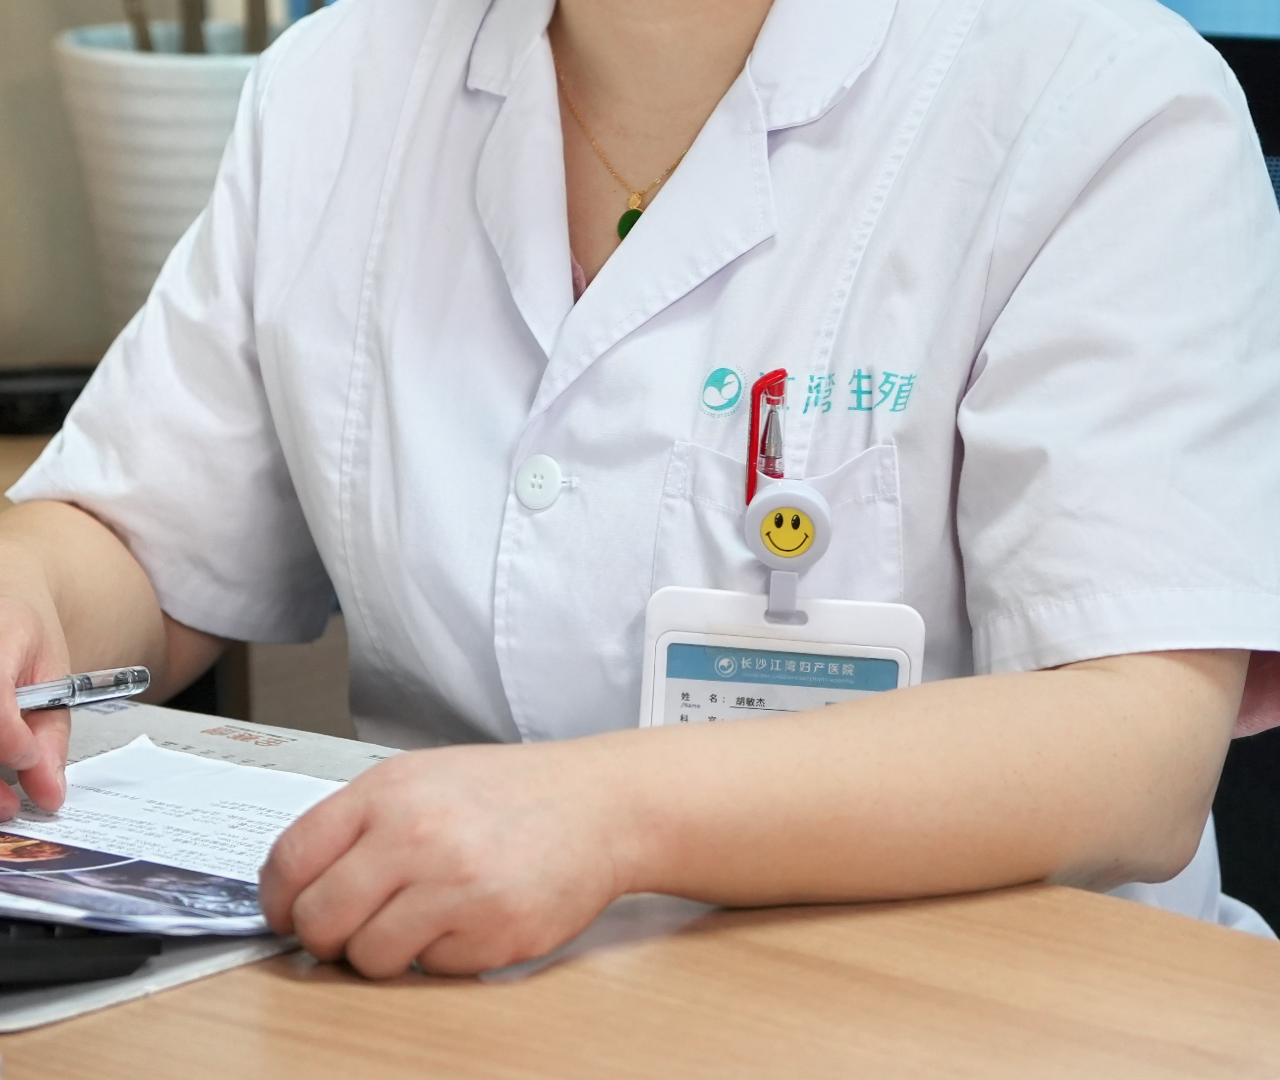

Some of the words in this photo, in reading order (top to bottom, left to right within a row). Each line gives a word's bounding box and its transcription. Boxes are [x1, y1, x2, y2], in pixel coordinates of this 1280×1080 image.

[760, 368, 917, 414] 湾生殖
[741, 657, 855, 676] 长沙江湾妇产医院
[736, 696, 766, 708] 胡敏杰
